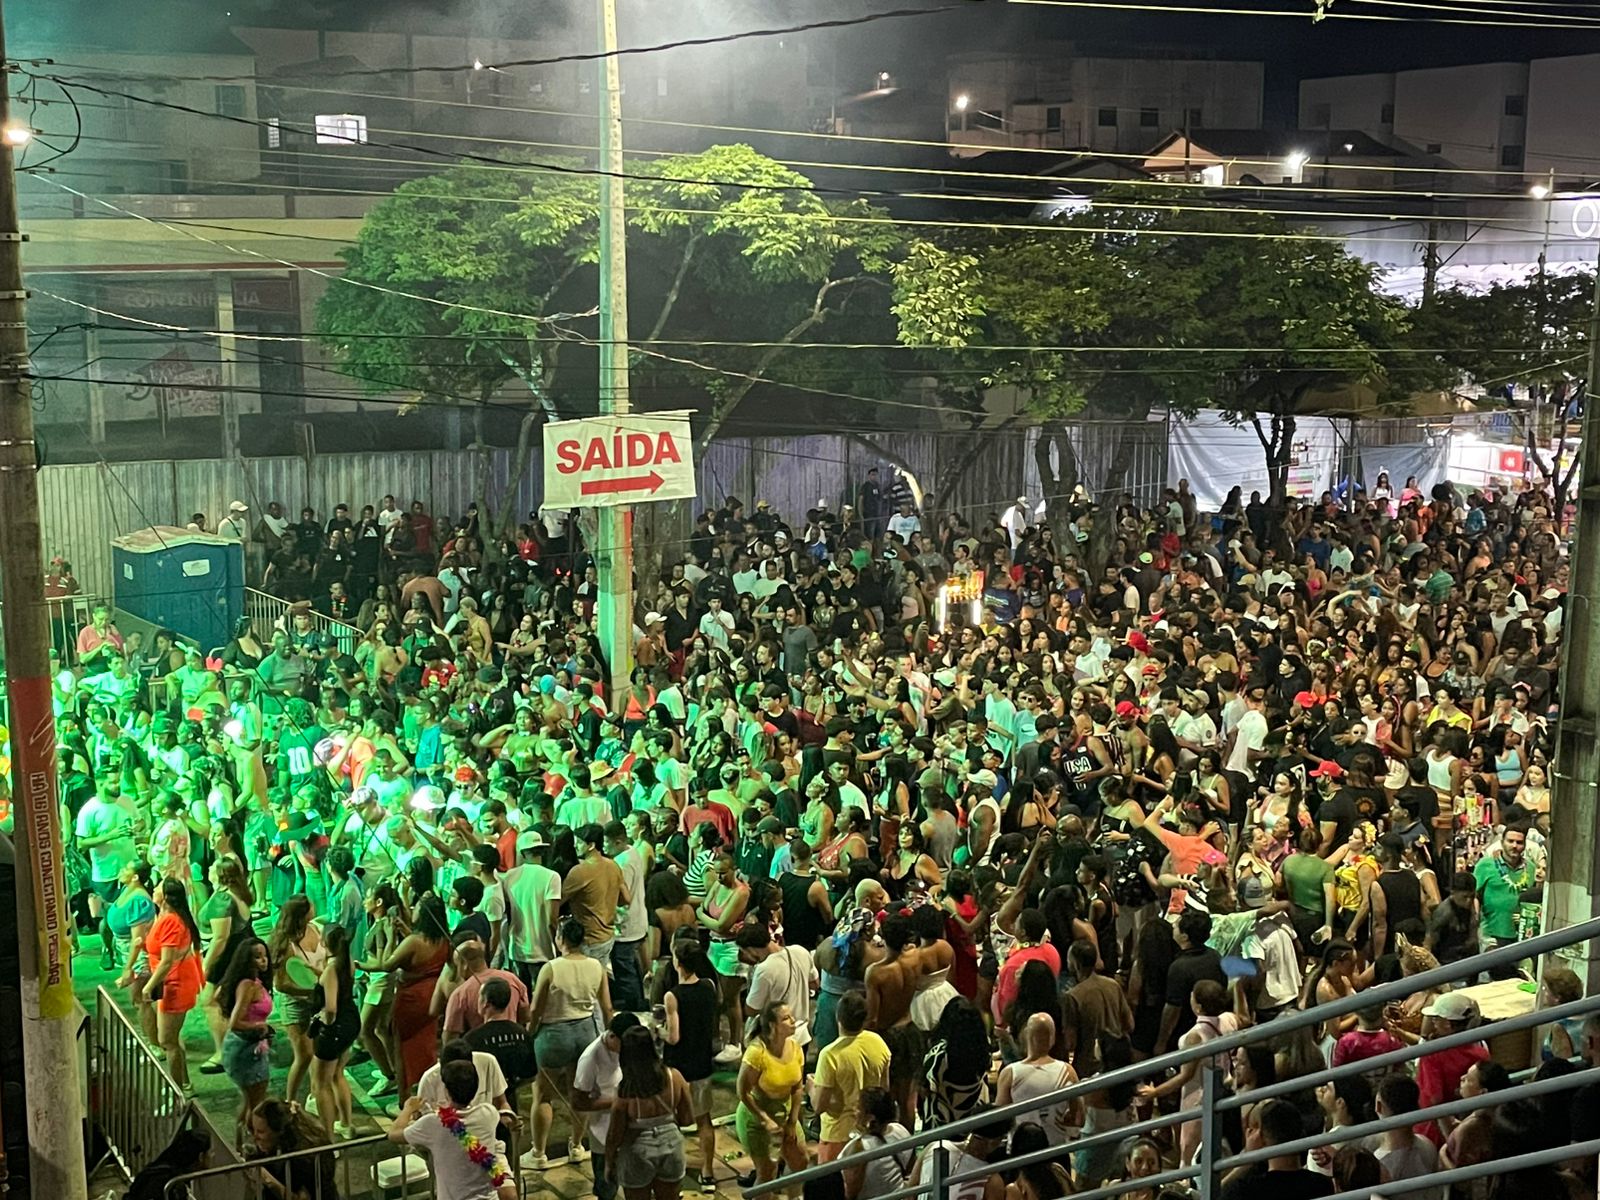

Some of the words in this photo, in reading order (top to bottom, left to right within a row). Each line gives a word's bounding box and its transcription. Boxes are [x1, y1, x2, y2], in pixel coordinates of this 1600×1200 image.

[556, 427, 681, 474] SAÍDA
[287, 746, 312, 775] 10
[1064, 756, 1092, 776] USA
[32, 793, 49, 812] 16
[34, 813, 52, 850] ANOS
[41, 851, 57, 930] CONECTANDO
